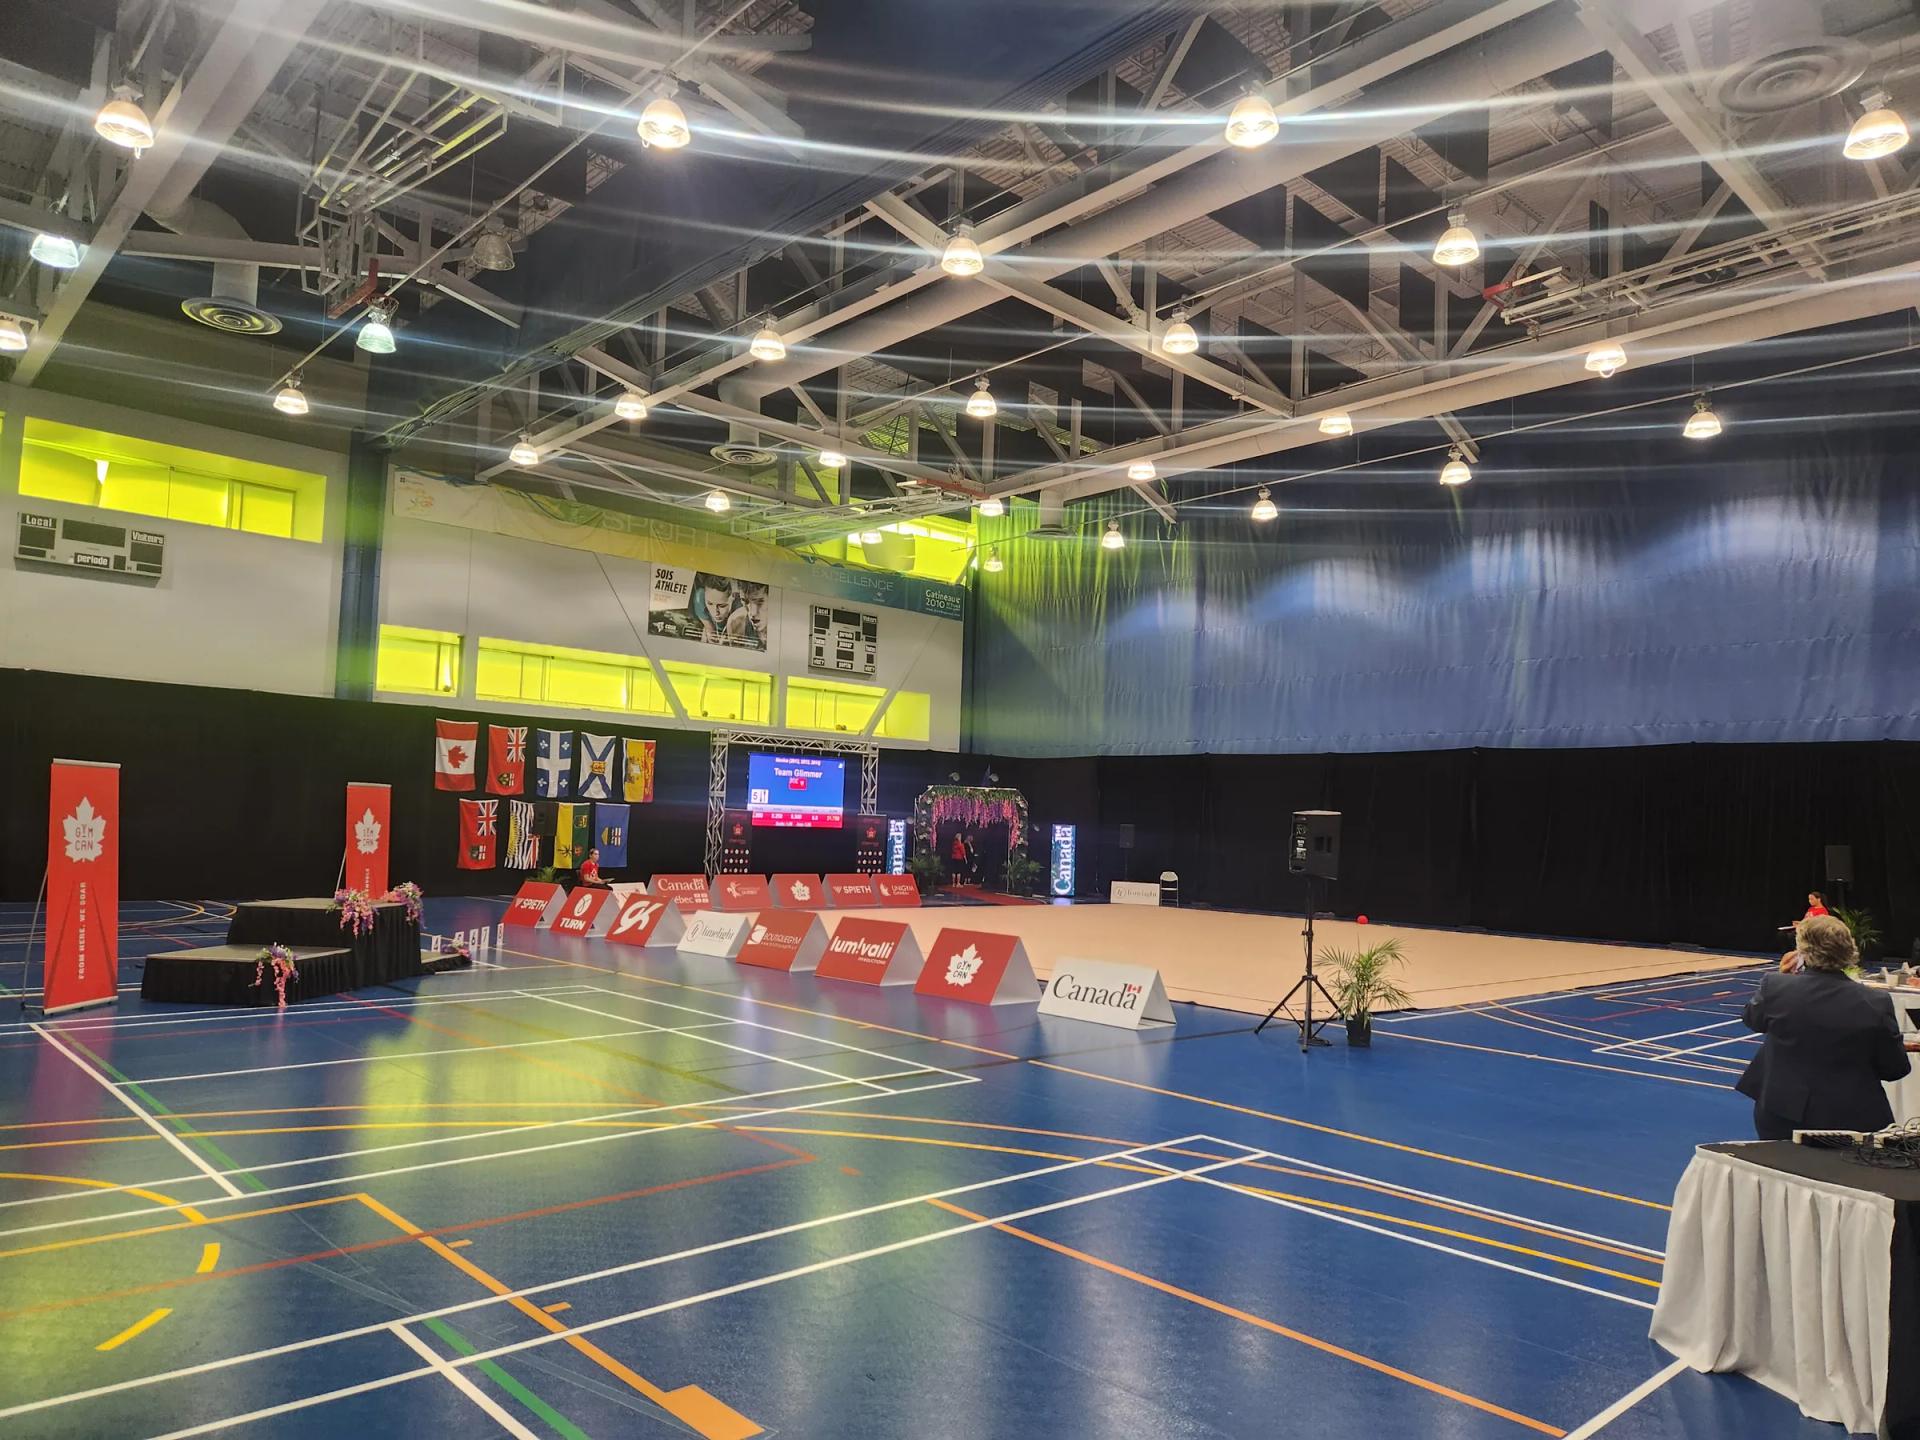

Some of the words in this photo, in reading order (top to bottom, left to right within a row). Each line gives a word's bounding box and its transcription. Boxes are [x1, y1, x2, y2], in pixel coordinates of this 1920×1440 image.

[26, 514, 52, 527] Local
[655, 568, 674, 580] SOIS
[925, 589, 956, 604] Gatineau
[925, 598, 946, 609] 2010
[774, 767, 792, 777] Team
[794, 769, 823, 778] Glimmer
[753, 792, 758, 800] 5
[75, 824, 94, 838] GYM
[75, 841, 94, 851] CAN
[890, 820, 905, 875] anada
[1053, 825, 1073, 895] Canada
[657, 878, 705, 891] Canada
[843, 885, 871, 894] SPIETH
[521, 899, 548, 911] SPIETH
[79, 908, 87, 921] WE
[559, 918, 586, 931] TURN
[702, 924, 736, 940] limelight
[78, 954, 86, 980] FROM
[956, 960, 972, 971] GYM
[952, 970, 968, 980] CAN
[1052, 974, 1138, 1010] Canada
